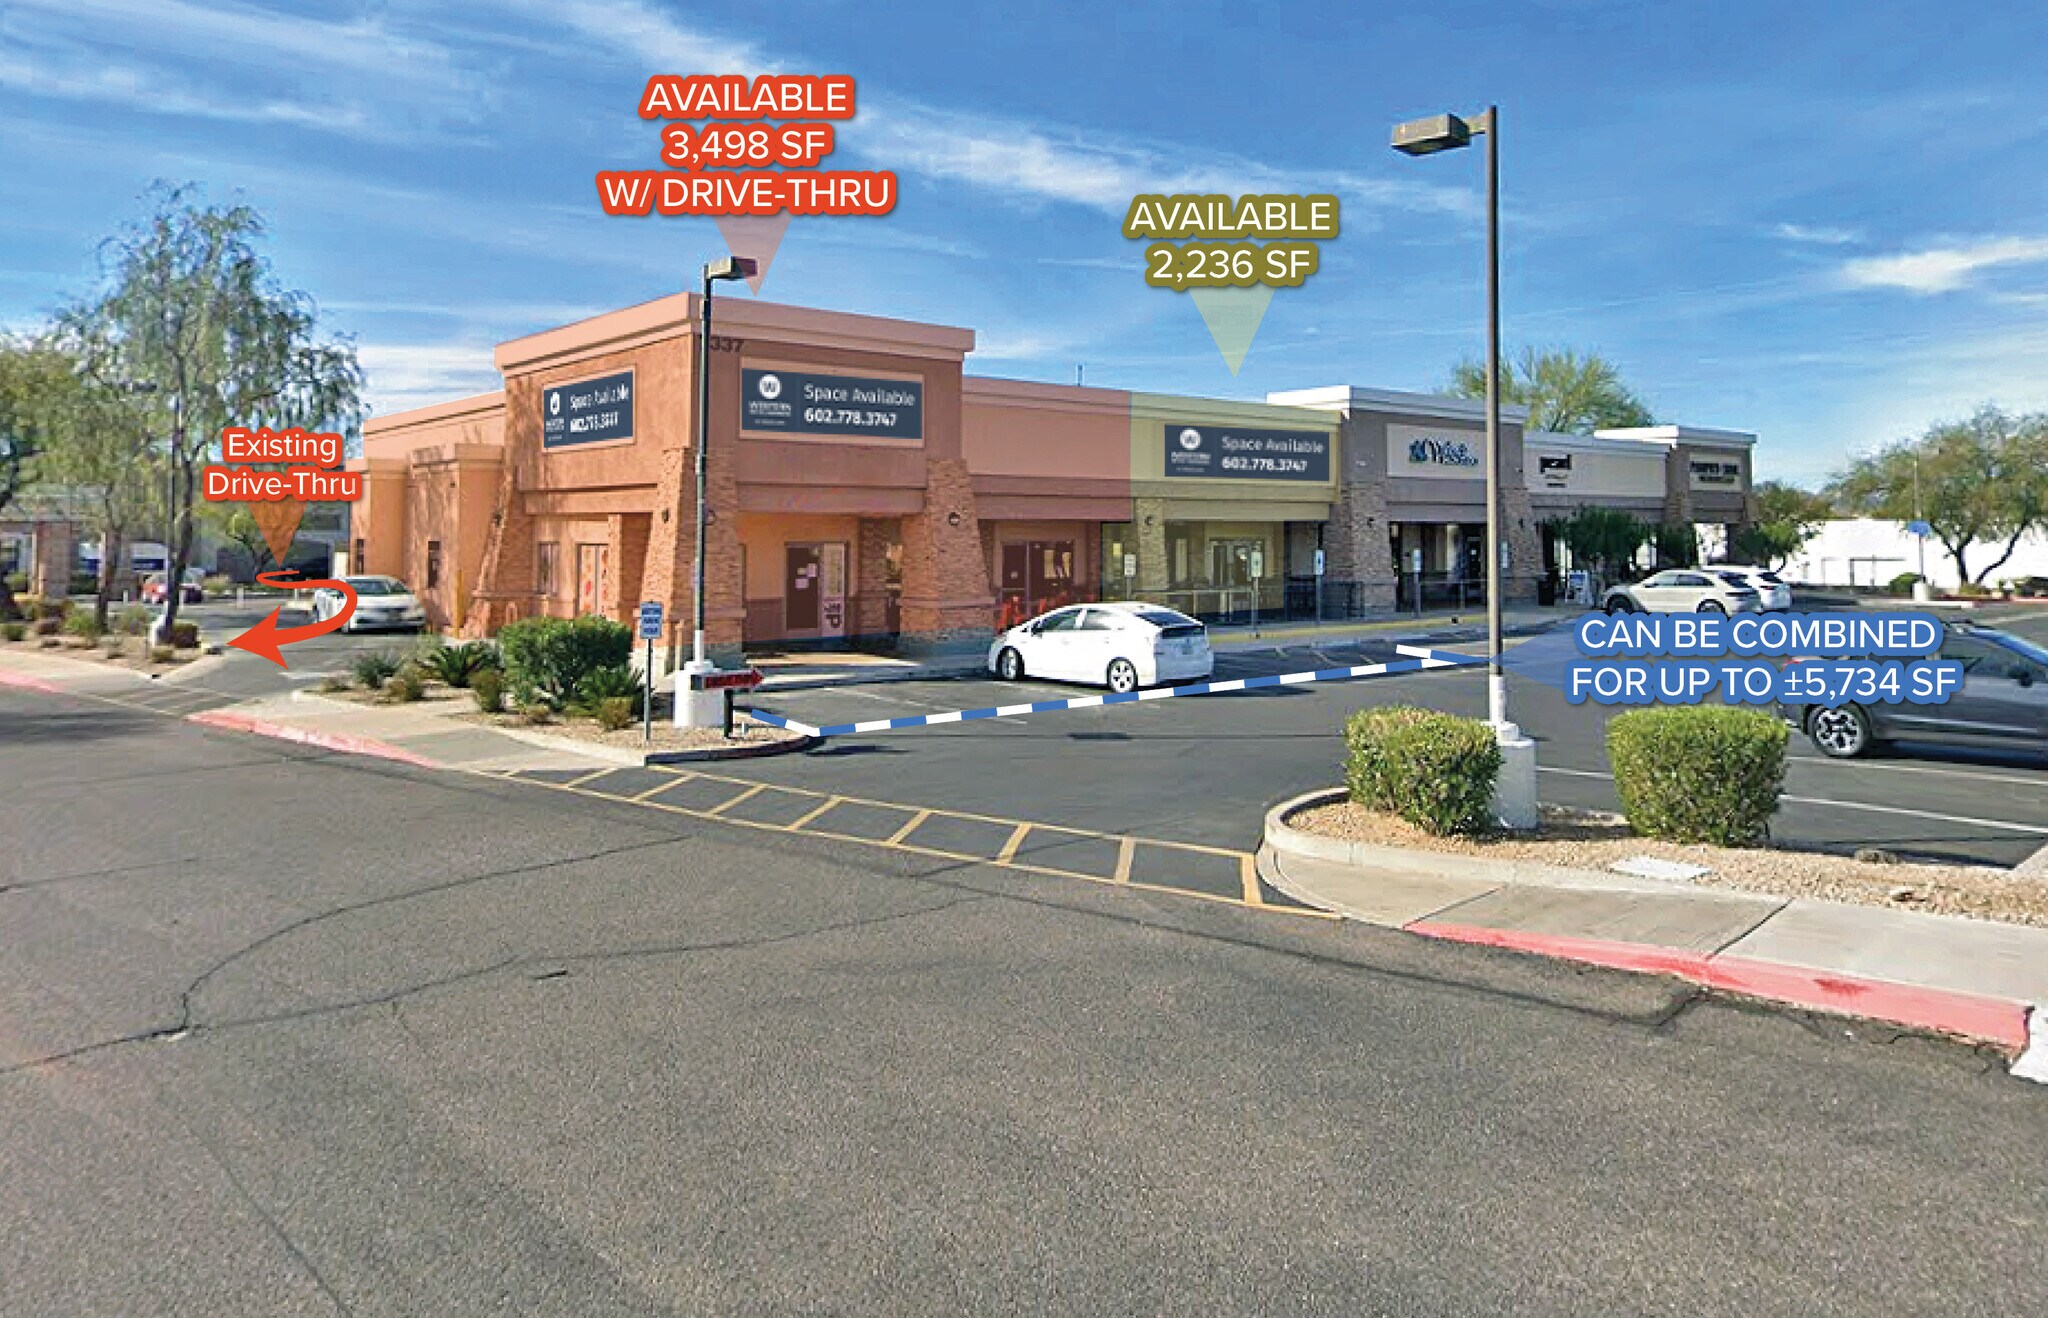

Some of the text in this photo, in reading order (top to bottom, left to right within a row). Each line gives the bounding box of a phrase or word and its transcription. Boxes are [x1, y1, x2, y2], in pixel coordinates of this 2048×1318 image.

[804, 383, 916, 407] Space Available
[804, 407, 897, 427] 602.778.3747
[1221, 435, 1324, 454] Space Available
[1221, 456, 1307, 473] 602.778.3747
